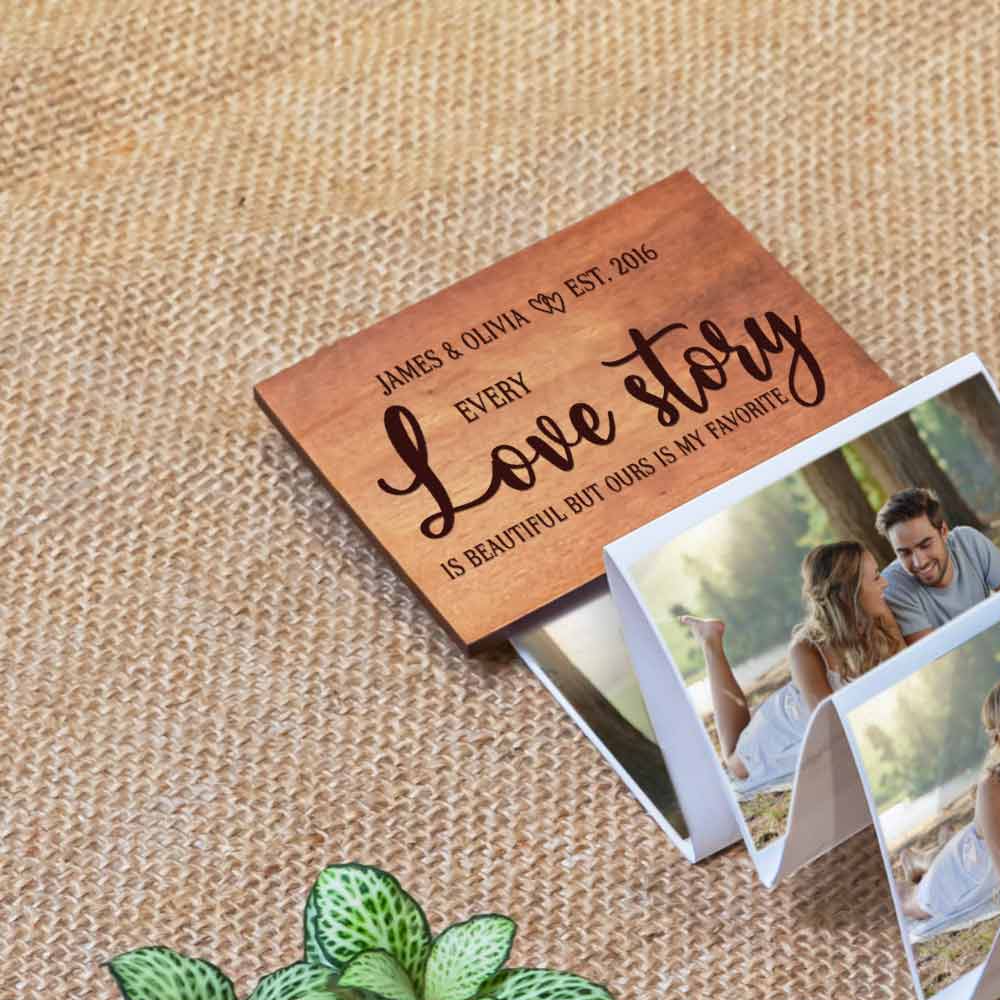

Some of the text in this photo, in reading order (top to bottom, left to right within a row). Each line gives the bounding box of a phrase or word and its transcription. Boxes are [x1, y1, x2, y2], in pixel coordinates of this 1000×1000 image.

[376, 243, 659, 396] JAMES & OLIVIA EST. 2016
[453, 371, 533, 425] EVERY
[377, 311, 826, 540] Love story
[440, 387, 790, 580] IS BEAUTIFUL BUT OURS IS MY FAVORITE
